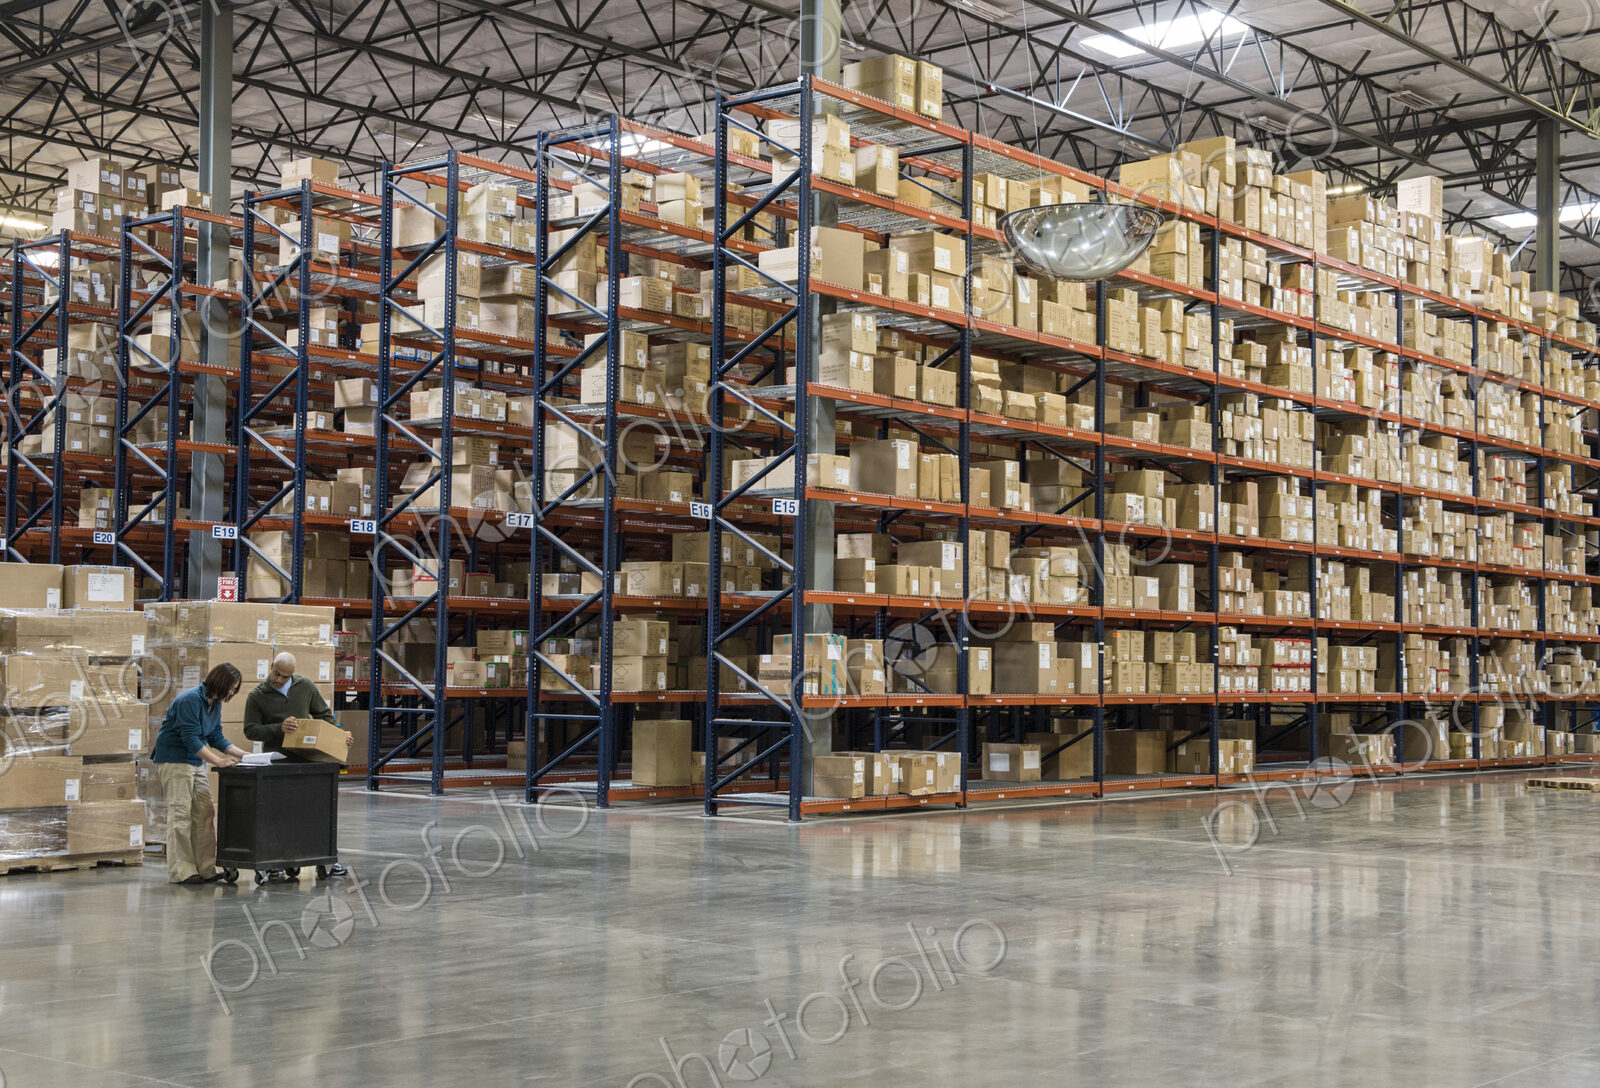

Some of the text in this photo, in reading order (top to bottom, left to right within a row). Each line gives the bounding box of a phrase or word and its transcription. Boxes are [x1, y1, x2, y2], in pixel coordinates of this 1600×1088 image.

[691, 503, 710, 518] E16
[774, 500, 796, 514] E15
[508, 513, 531, 526] E17
[213, 526, 235, 538] E19
[351, 520, 374, 533] E18
[94, 532, 113, 543] E20
